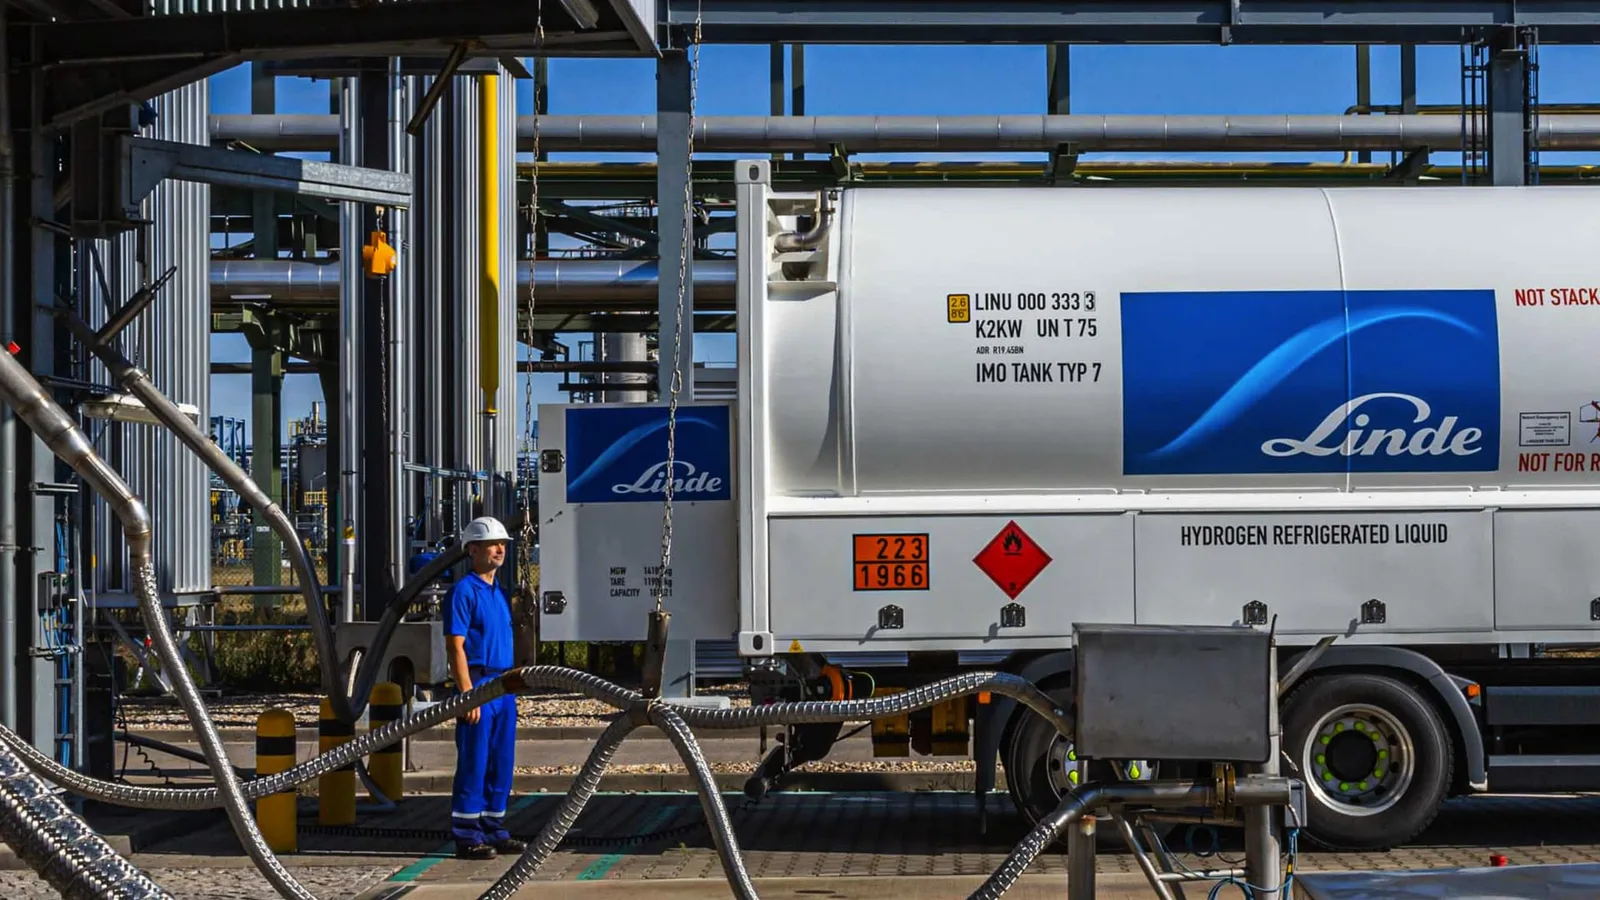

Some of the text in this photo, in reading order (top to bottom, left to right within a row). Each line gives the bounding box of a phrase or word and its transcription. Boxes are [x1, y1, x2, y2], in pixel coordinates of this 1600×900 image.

[975, 292, 1095, 311] LINU 000 333 3
[1514, 288, 1545, 307] NOT
[975, 318, 1097, 339] K2KW UN T 75
[975, 345, 990, 355] ADR
[976, 362, 1102, 383] IMO TANK TYP 7
[1261, 392, 1482, 457] Linde
[1518, 453, 1550, 472] NOT
[1554, 453, 1586, 472] FOR
[611, 460, 722, 494] Linde
[1181, 523, 1448, 546] HYDROGEN REFRIGERATED LIQUID
[876, 538, 923, 559] 223
[609, 577, 626, 587] TARE
[861, 565, 923, 587] 1966
[609, 588, 641, 598] CAPACITY
